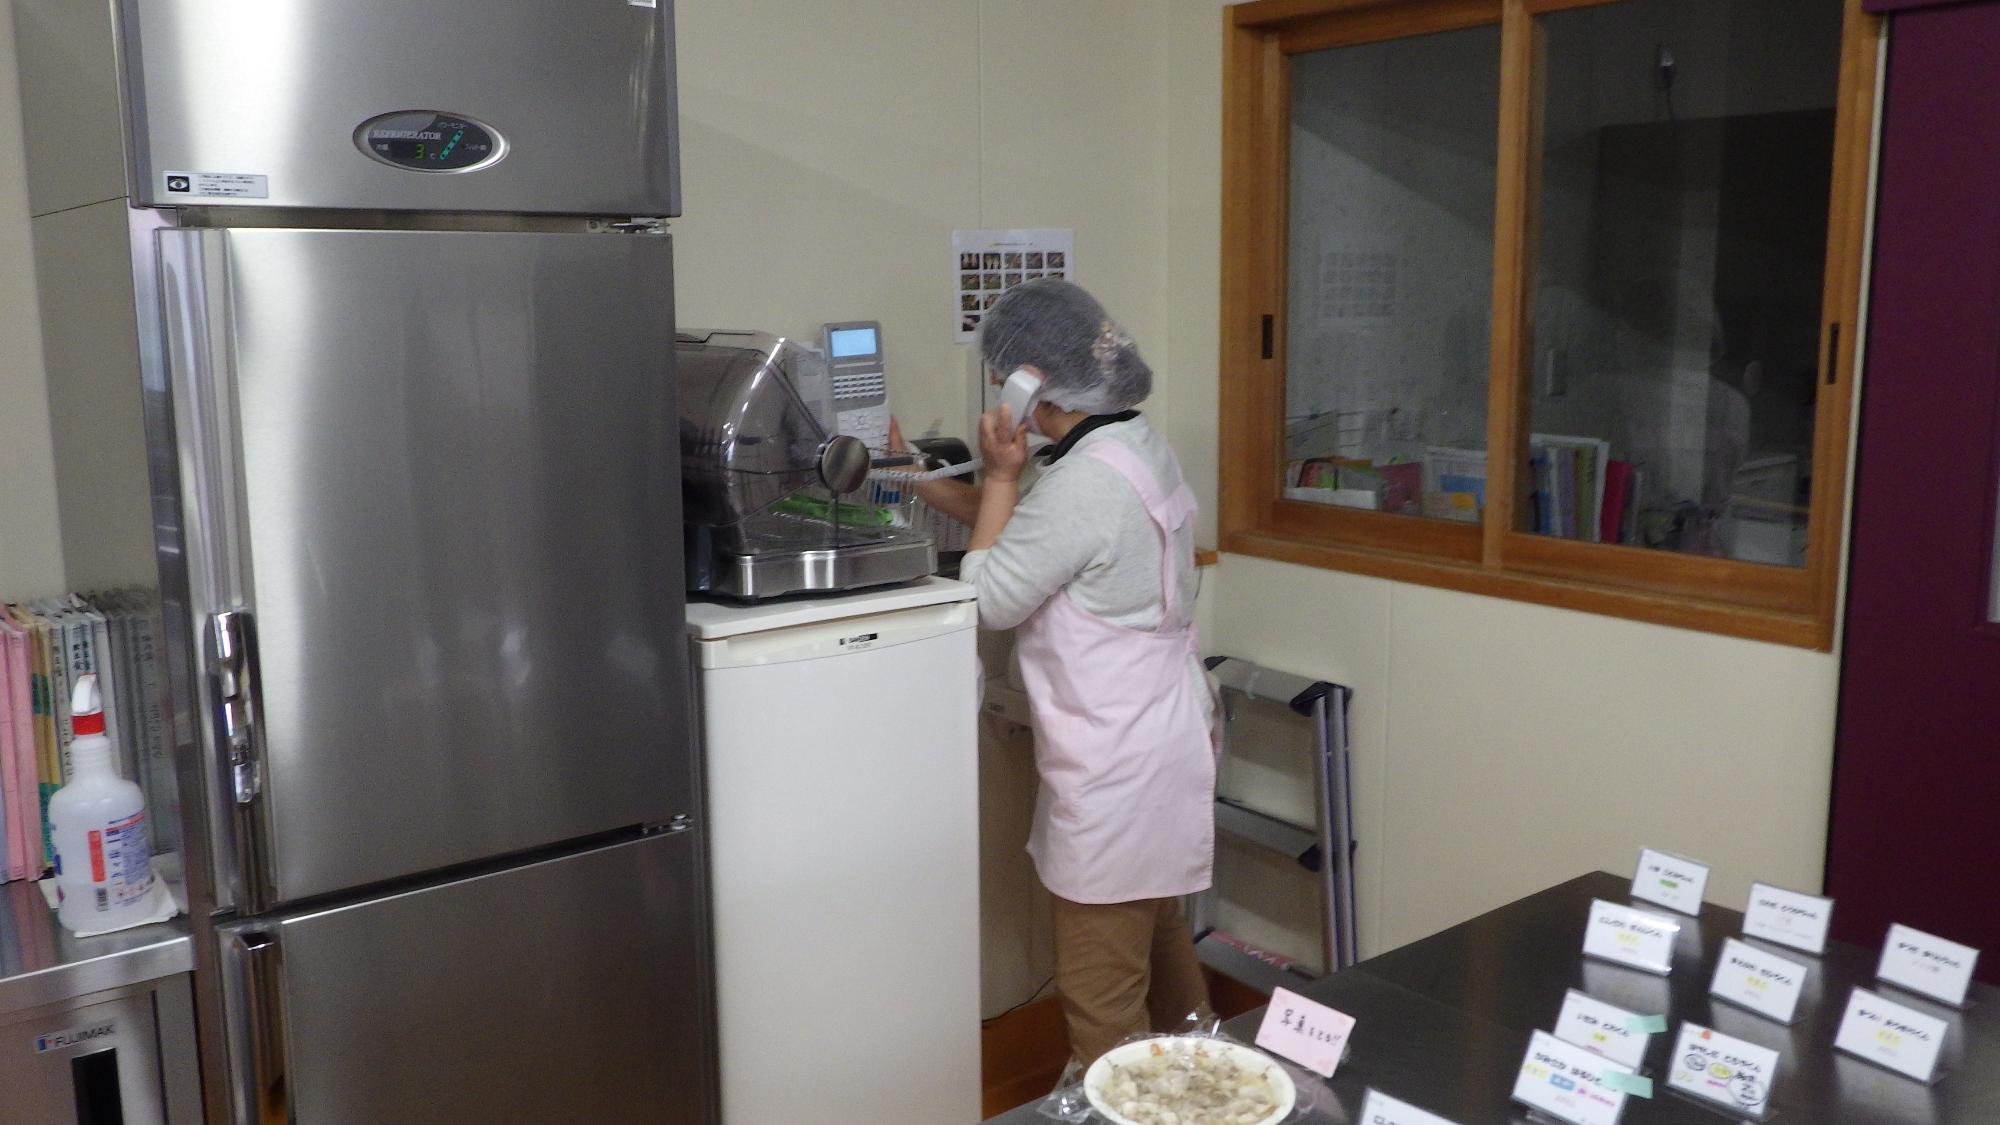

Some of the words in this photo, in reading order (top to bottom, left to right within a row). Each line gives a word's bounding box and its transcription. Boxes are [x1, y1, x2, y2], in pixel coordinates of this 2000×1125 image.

[373, 129, 442, 140] REFRIGERATOR
[416, 144, 425, 160] 3
[55, 1025, 116, 1046] FUJIMAK
